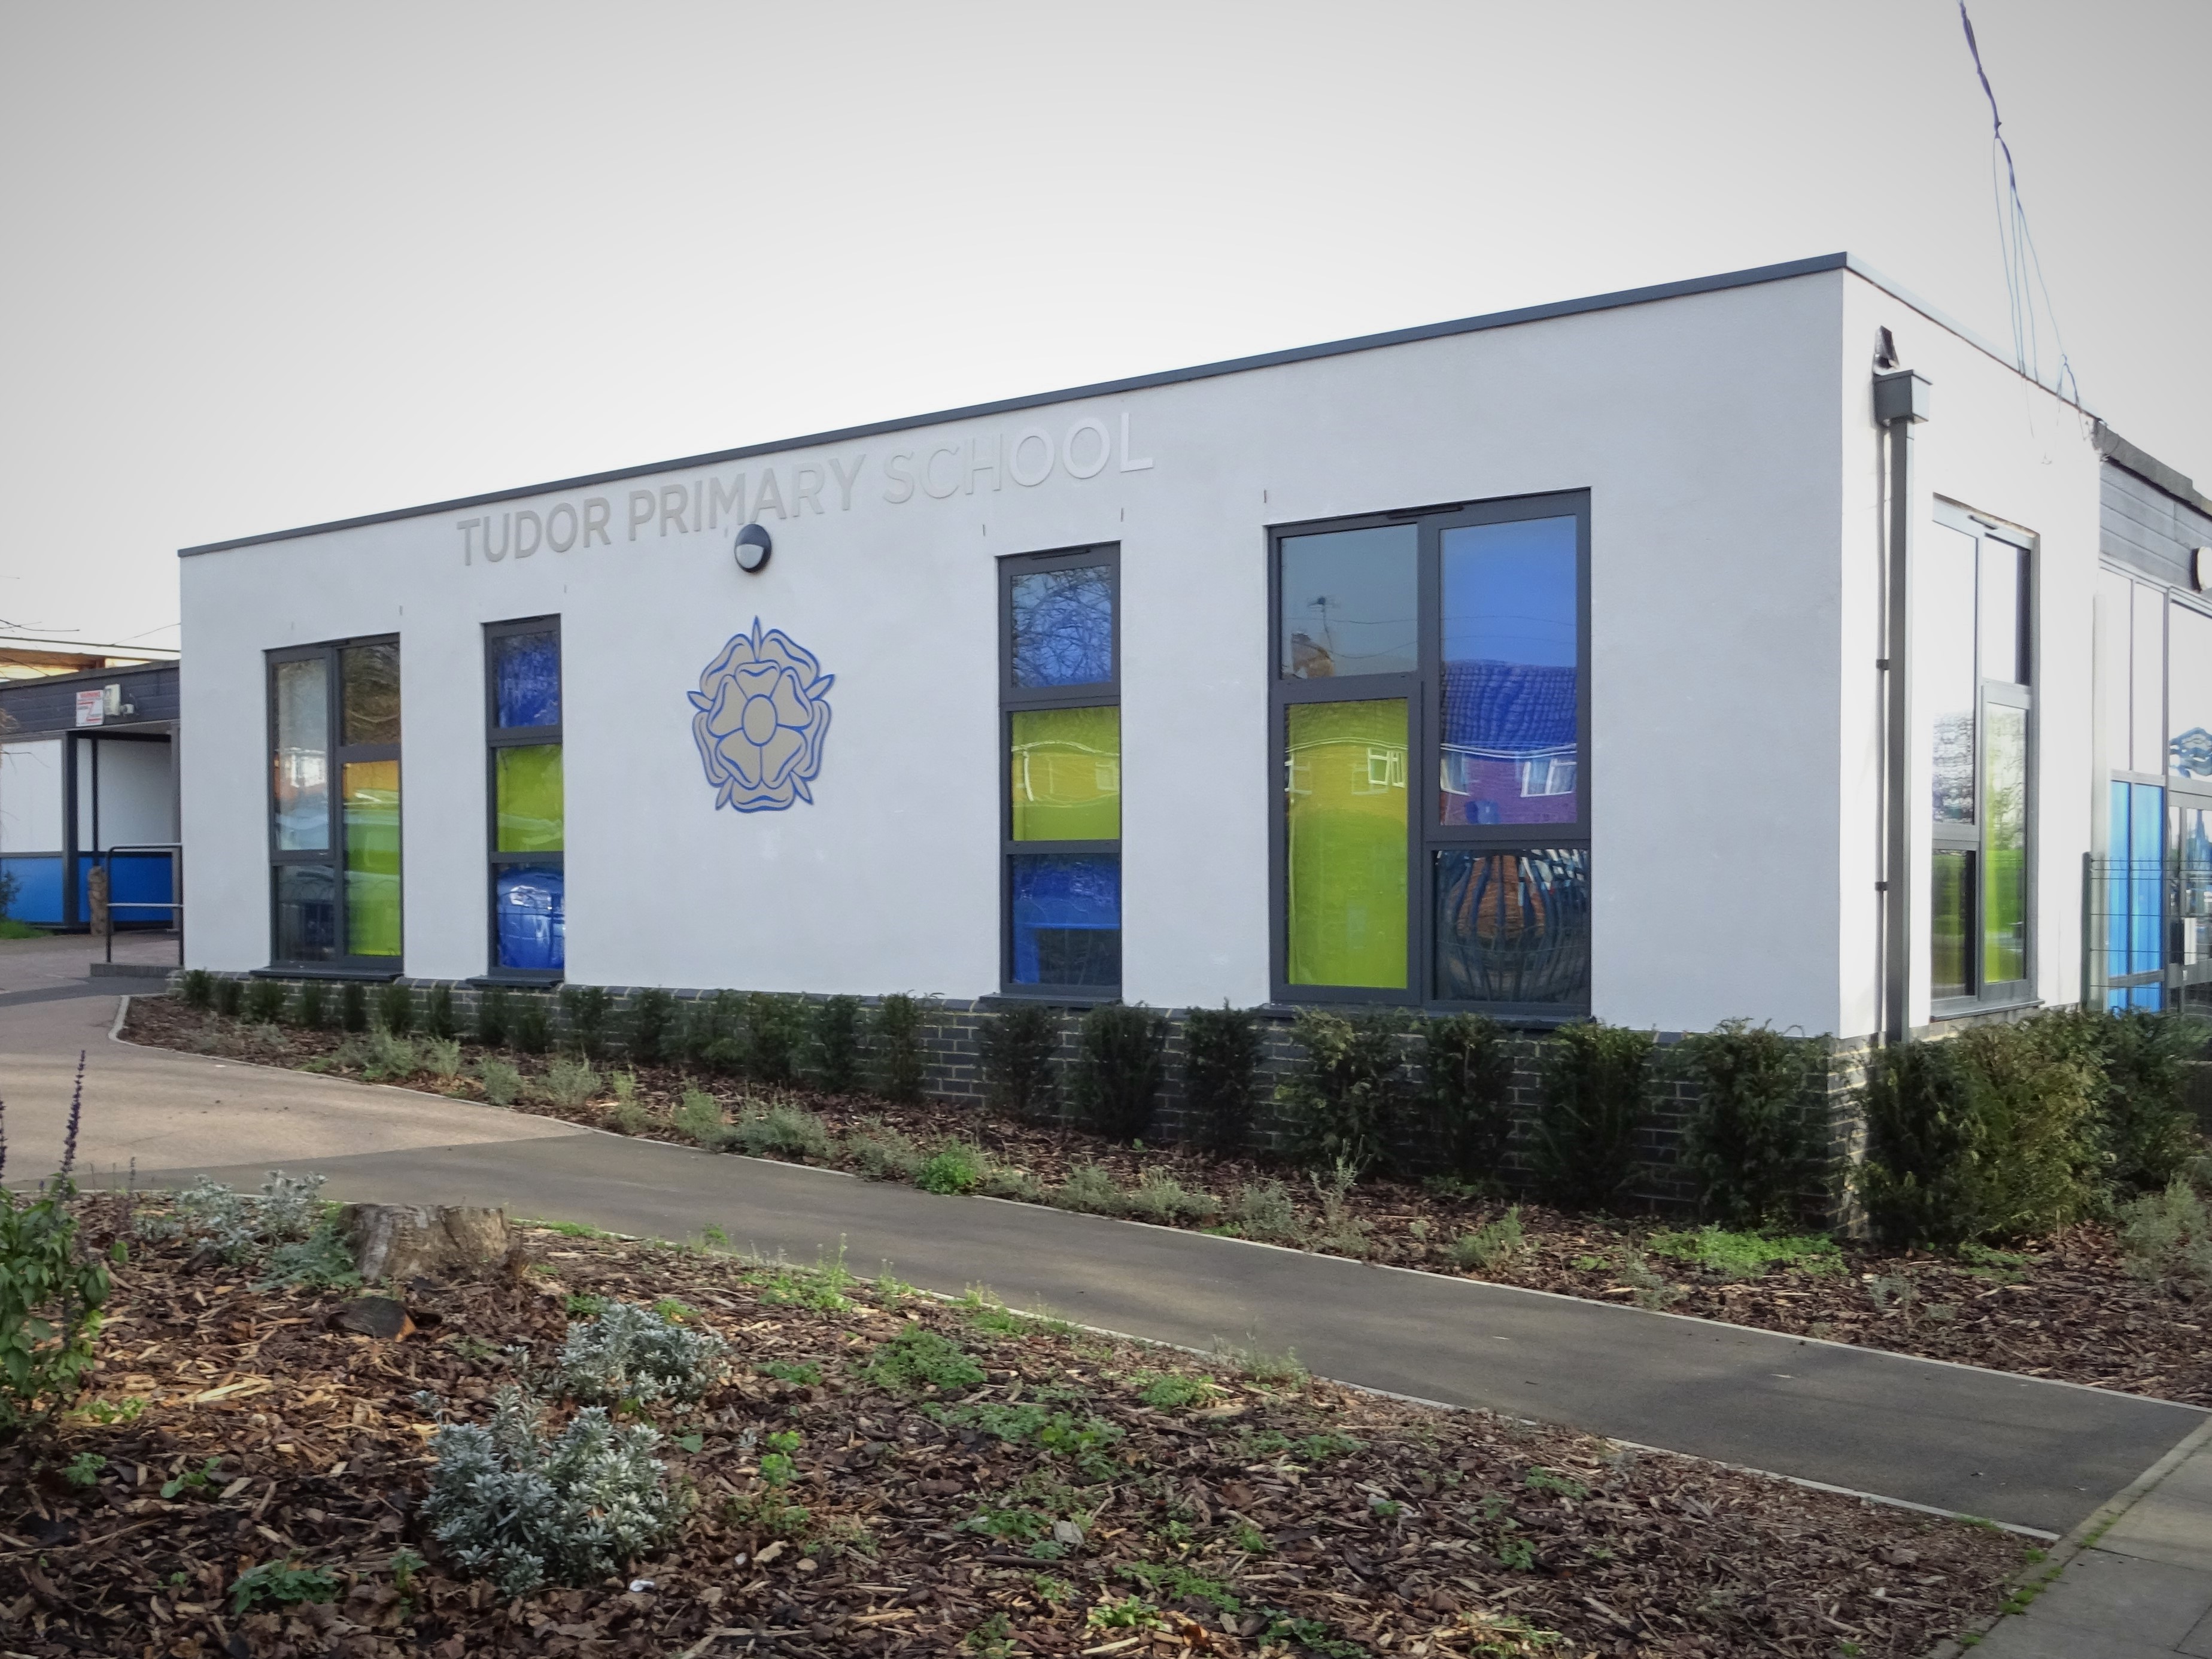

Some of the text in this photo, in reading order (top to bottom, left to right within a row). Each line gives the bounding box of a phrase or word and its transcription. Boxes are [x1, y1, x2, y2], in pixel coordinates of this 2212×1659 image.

[457, 412, 1154, 566] TUDOR PRIMARY SCHOOL
